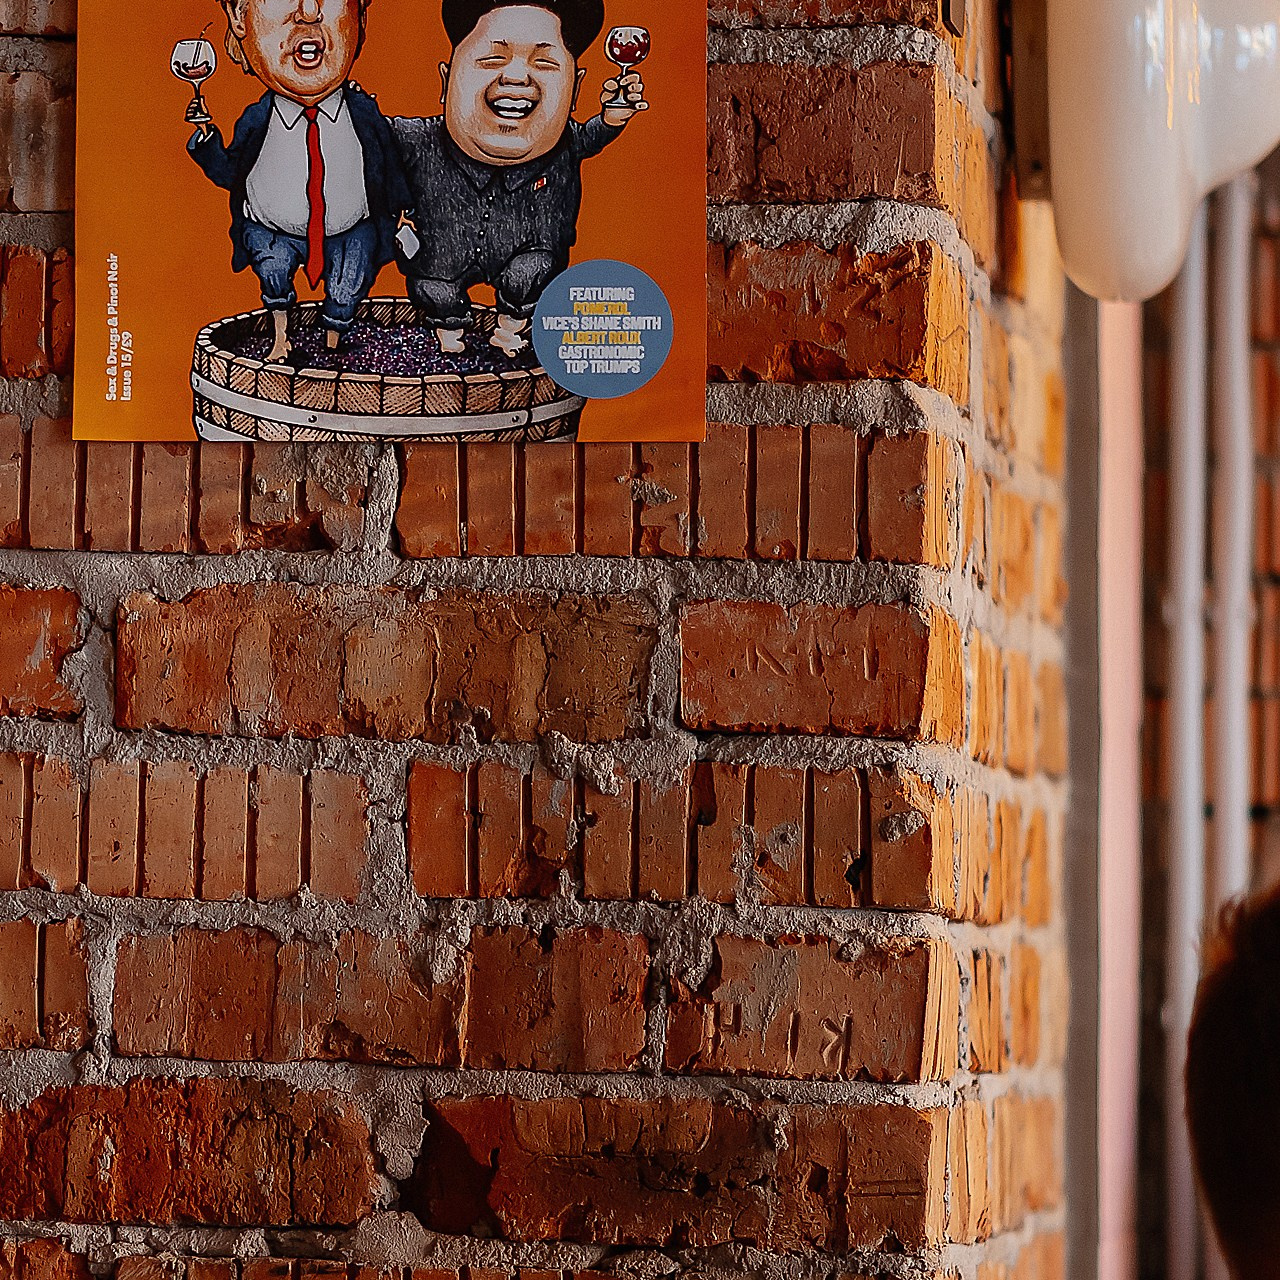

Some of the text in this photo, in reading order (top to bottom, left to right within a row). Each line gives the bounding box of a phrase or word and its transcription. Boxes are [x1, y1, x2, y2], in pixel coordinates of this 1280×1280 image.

[569, 287, 635, 301] FEATURING
[573, 302, 631, 316] POMEROL
[106, 253, 120, 401] Sex & Drugs & Pinot Noir
[542, 316, 662, 330] VICE'S SHANE SMITH
[561, 331, 641, 345] ALBERT ROUX
[558, 345, 645, 360] GASTRONOMIC
[564, 360, 641, 374] TOP TRUMPS
[120, 371, 132, 401] Issue
